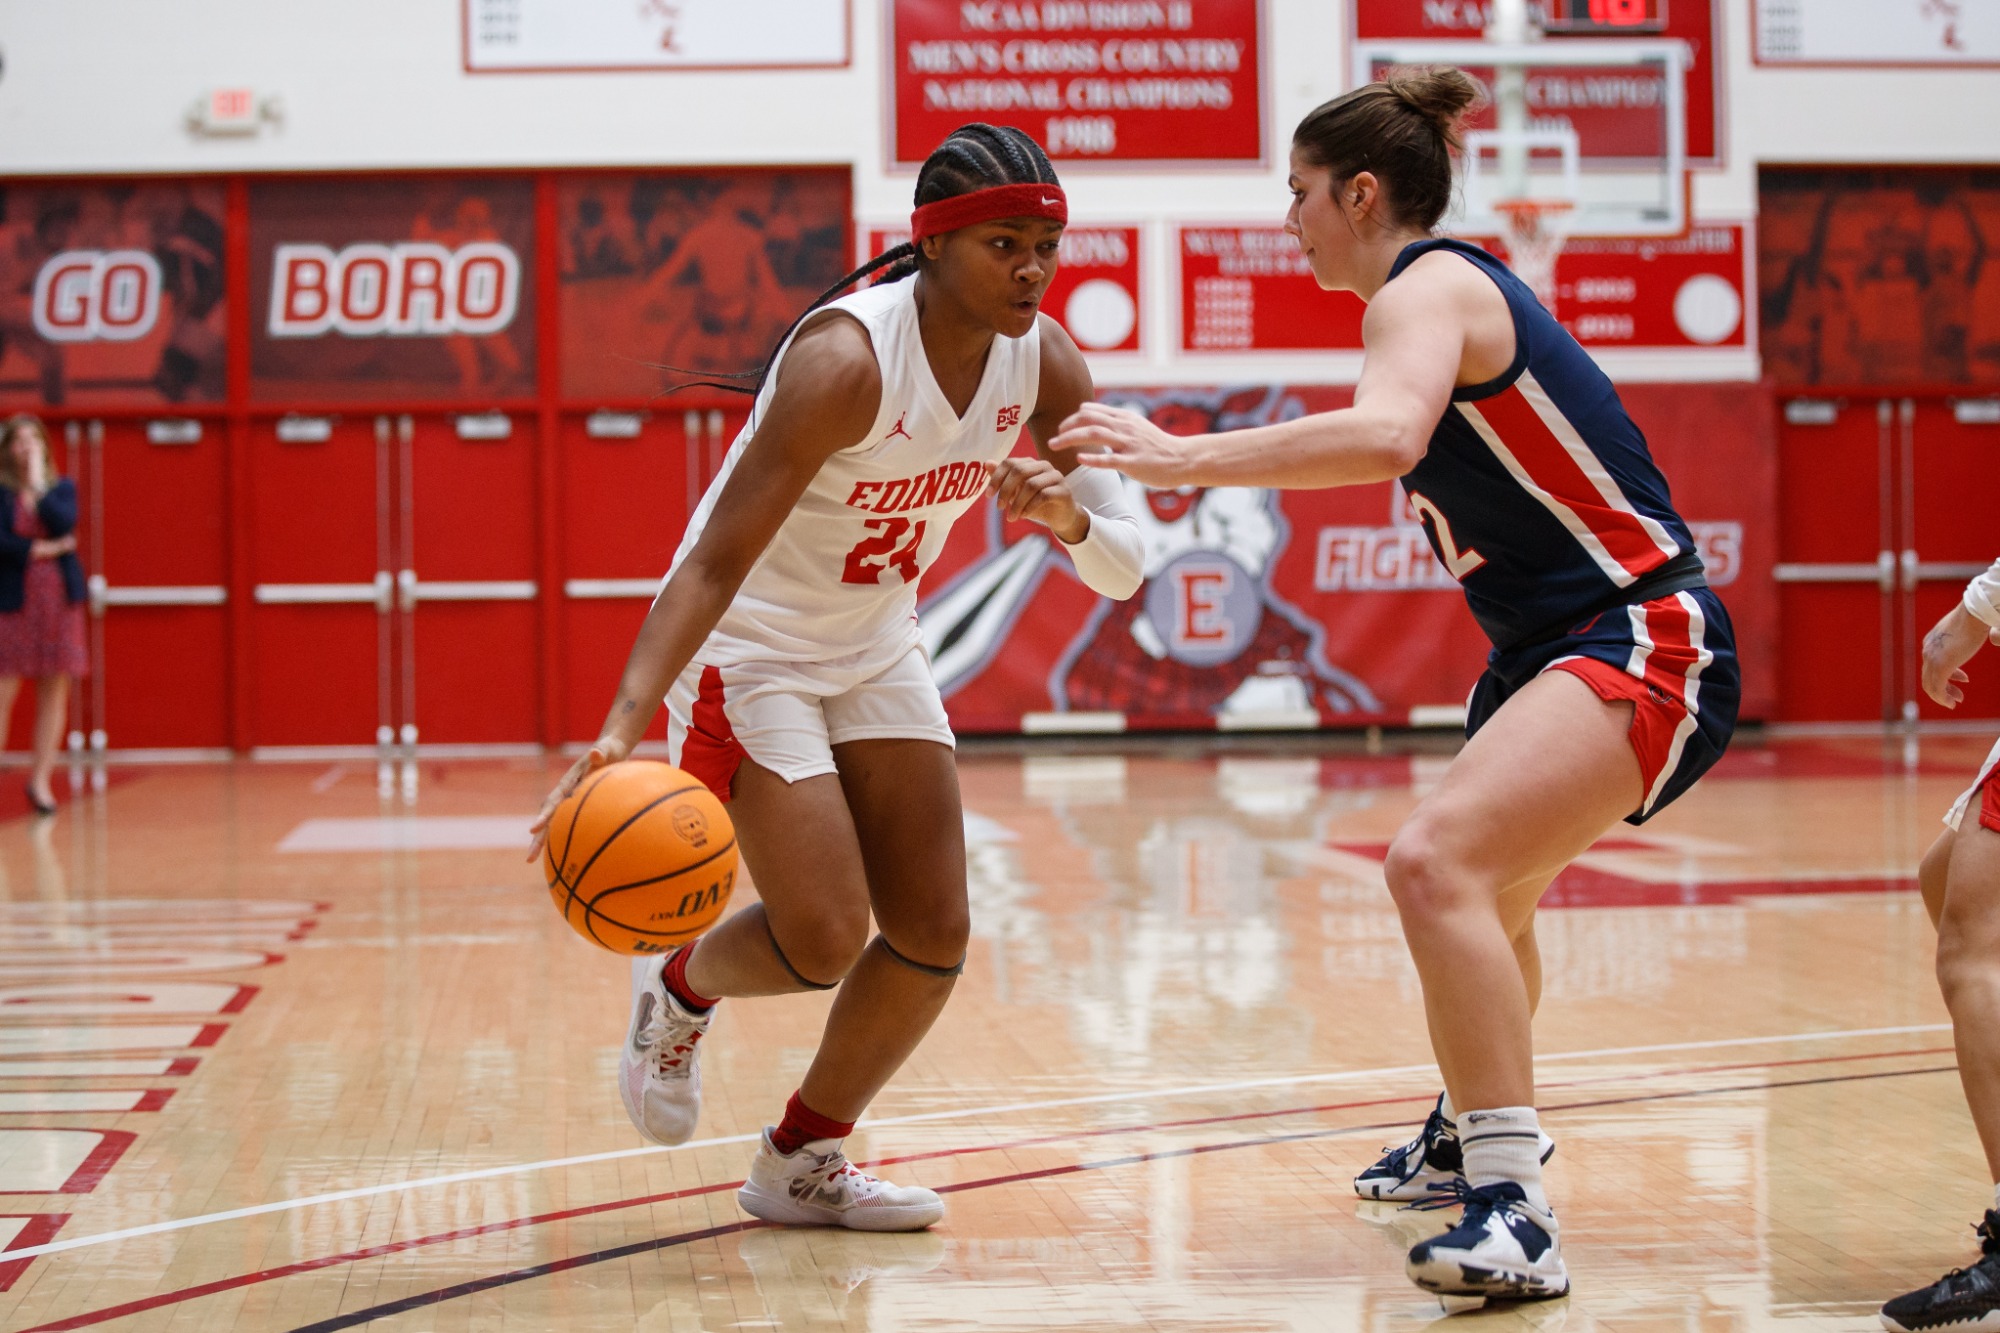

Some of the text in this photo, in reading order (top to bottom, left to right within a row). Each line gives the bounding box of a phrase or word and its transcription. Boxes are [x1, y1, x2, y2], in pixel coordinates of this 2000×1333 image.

[1003, 40, 1099, 71] CROSS
[1102, 40, 1242, 71] COUNTRY
[925, 79, 1232, 110] NATIONAL CHAMPIONS
[36, 252, 159, 339] GO
[270, 245, 519, 335] BORO
[841, 517, 926, 585] 24
[1173, 566, 1231, 648] E
